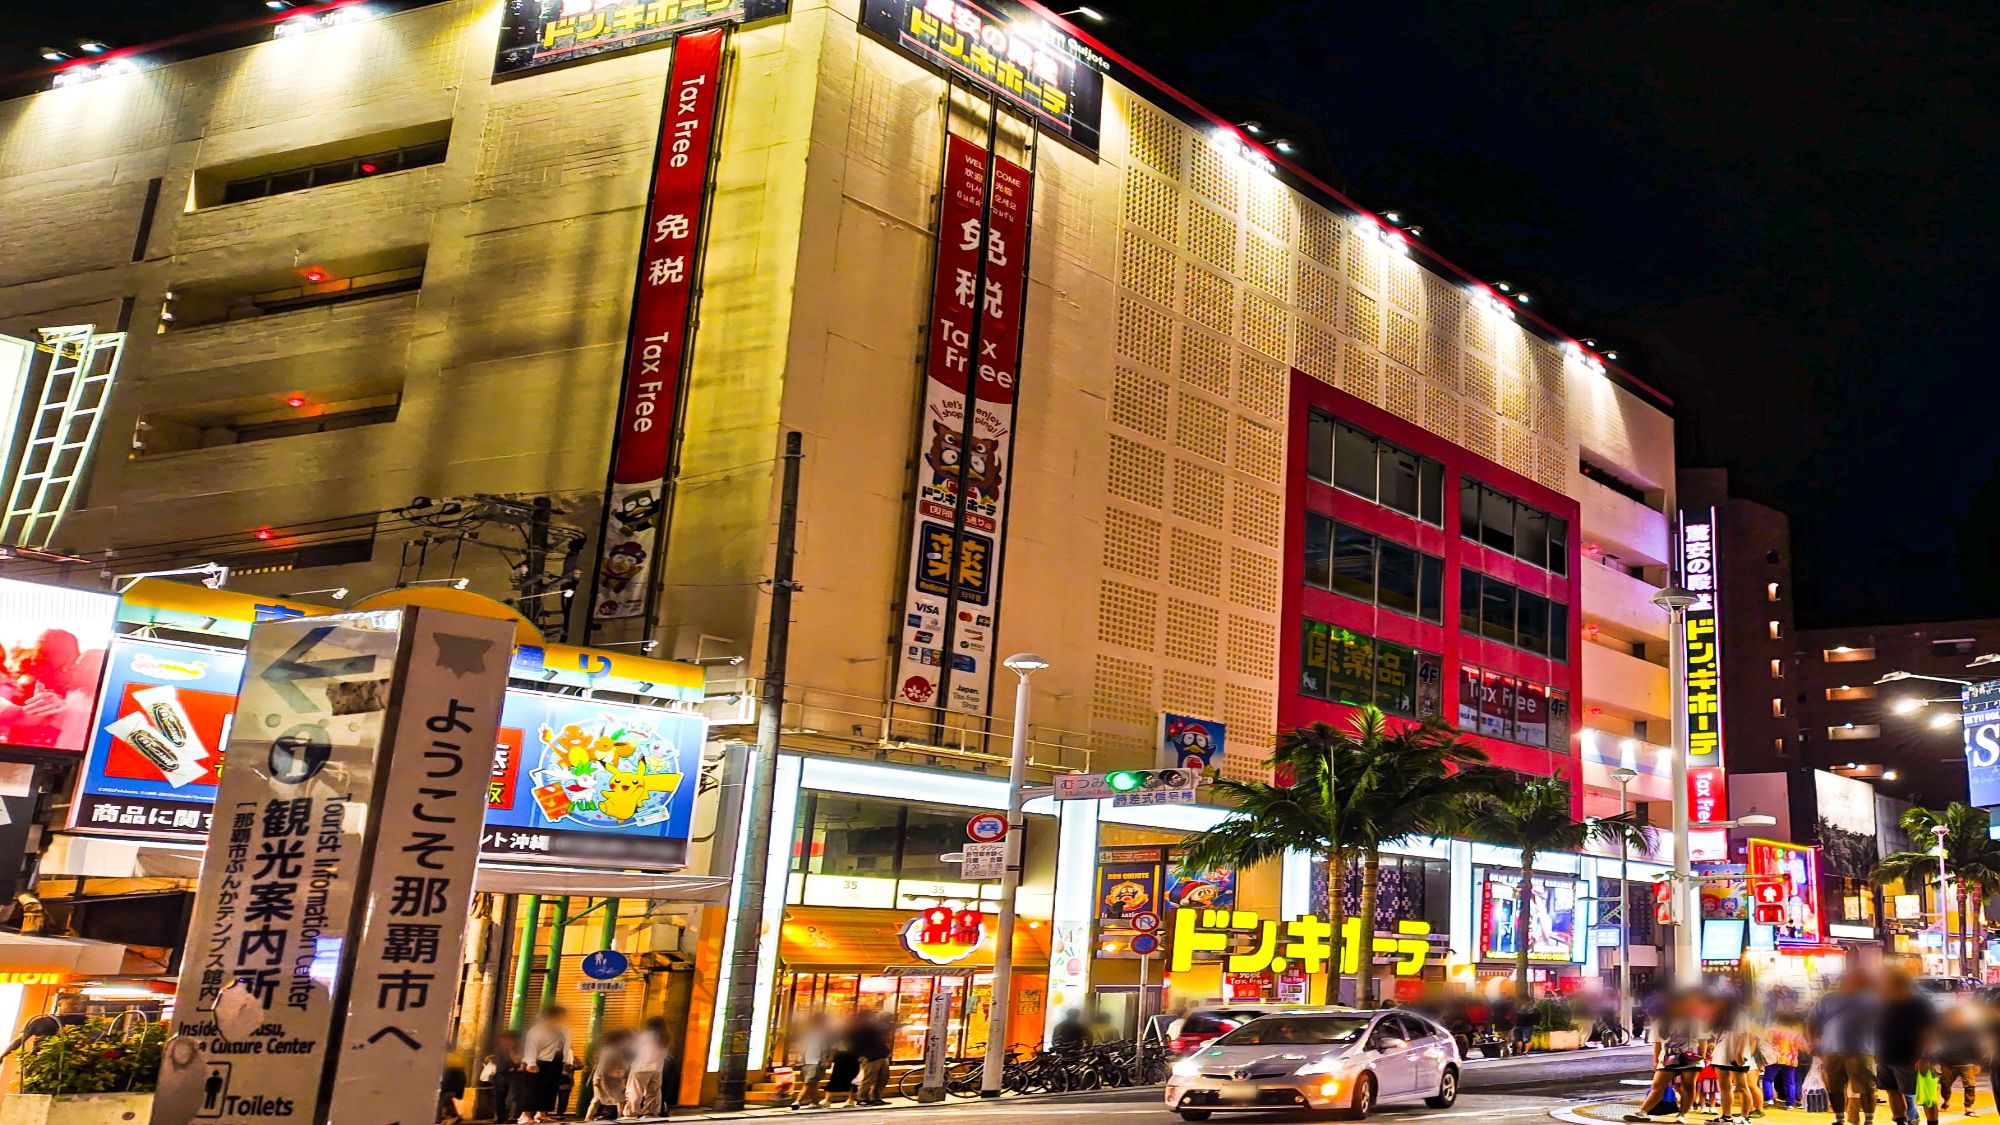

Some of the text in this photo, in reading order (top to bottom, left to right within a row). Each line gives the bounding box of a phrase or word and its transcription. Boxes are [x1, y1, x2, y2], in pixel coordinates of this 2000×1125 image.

[910, 6, 1067, 113] ドン.キホーテ
[1067, 35, 1111, 70] Quijote
[669, 74, 706, 168] Tax Free
[648, 213, 690, 286] 免税
[633, 331, 669, 432] Tax Free
[945, 346, 1014, 389] Free
[926, 532, 986, 588] 薬
[915, 602, 940, 616] VISA
[1420, 661, 1440, 684] 4F
[1687, 618, 1718, 756] ドン.キホーテ
[1503, 687, 1537, 713] Free
[1115, 791, 1194, 807] 時差式信号機
[1696, 771, 1713, 797] Tax
[368, 698, 476, 1051] ようこそ那覇市へ
[843, 880, 858, 889] 35
[932, 886, 945, 894] 35
[233, 797, 314, 1010] 観光案内所
[287, 793, 353, 1012] Tourist Information Center
[178, 1021, 218, 1036] Inside
[266, 1037, 317, 1054] Center
[226, 1095, 294, 1117] Toilets
